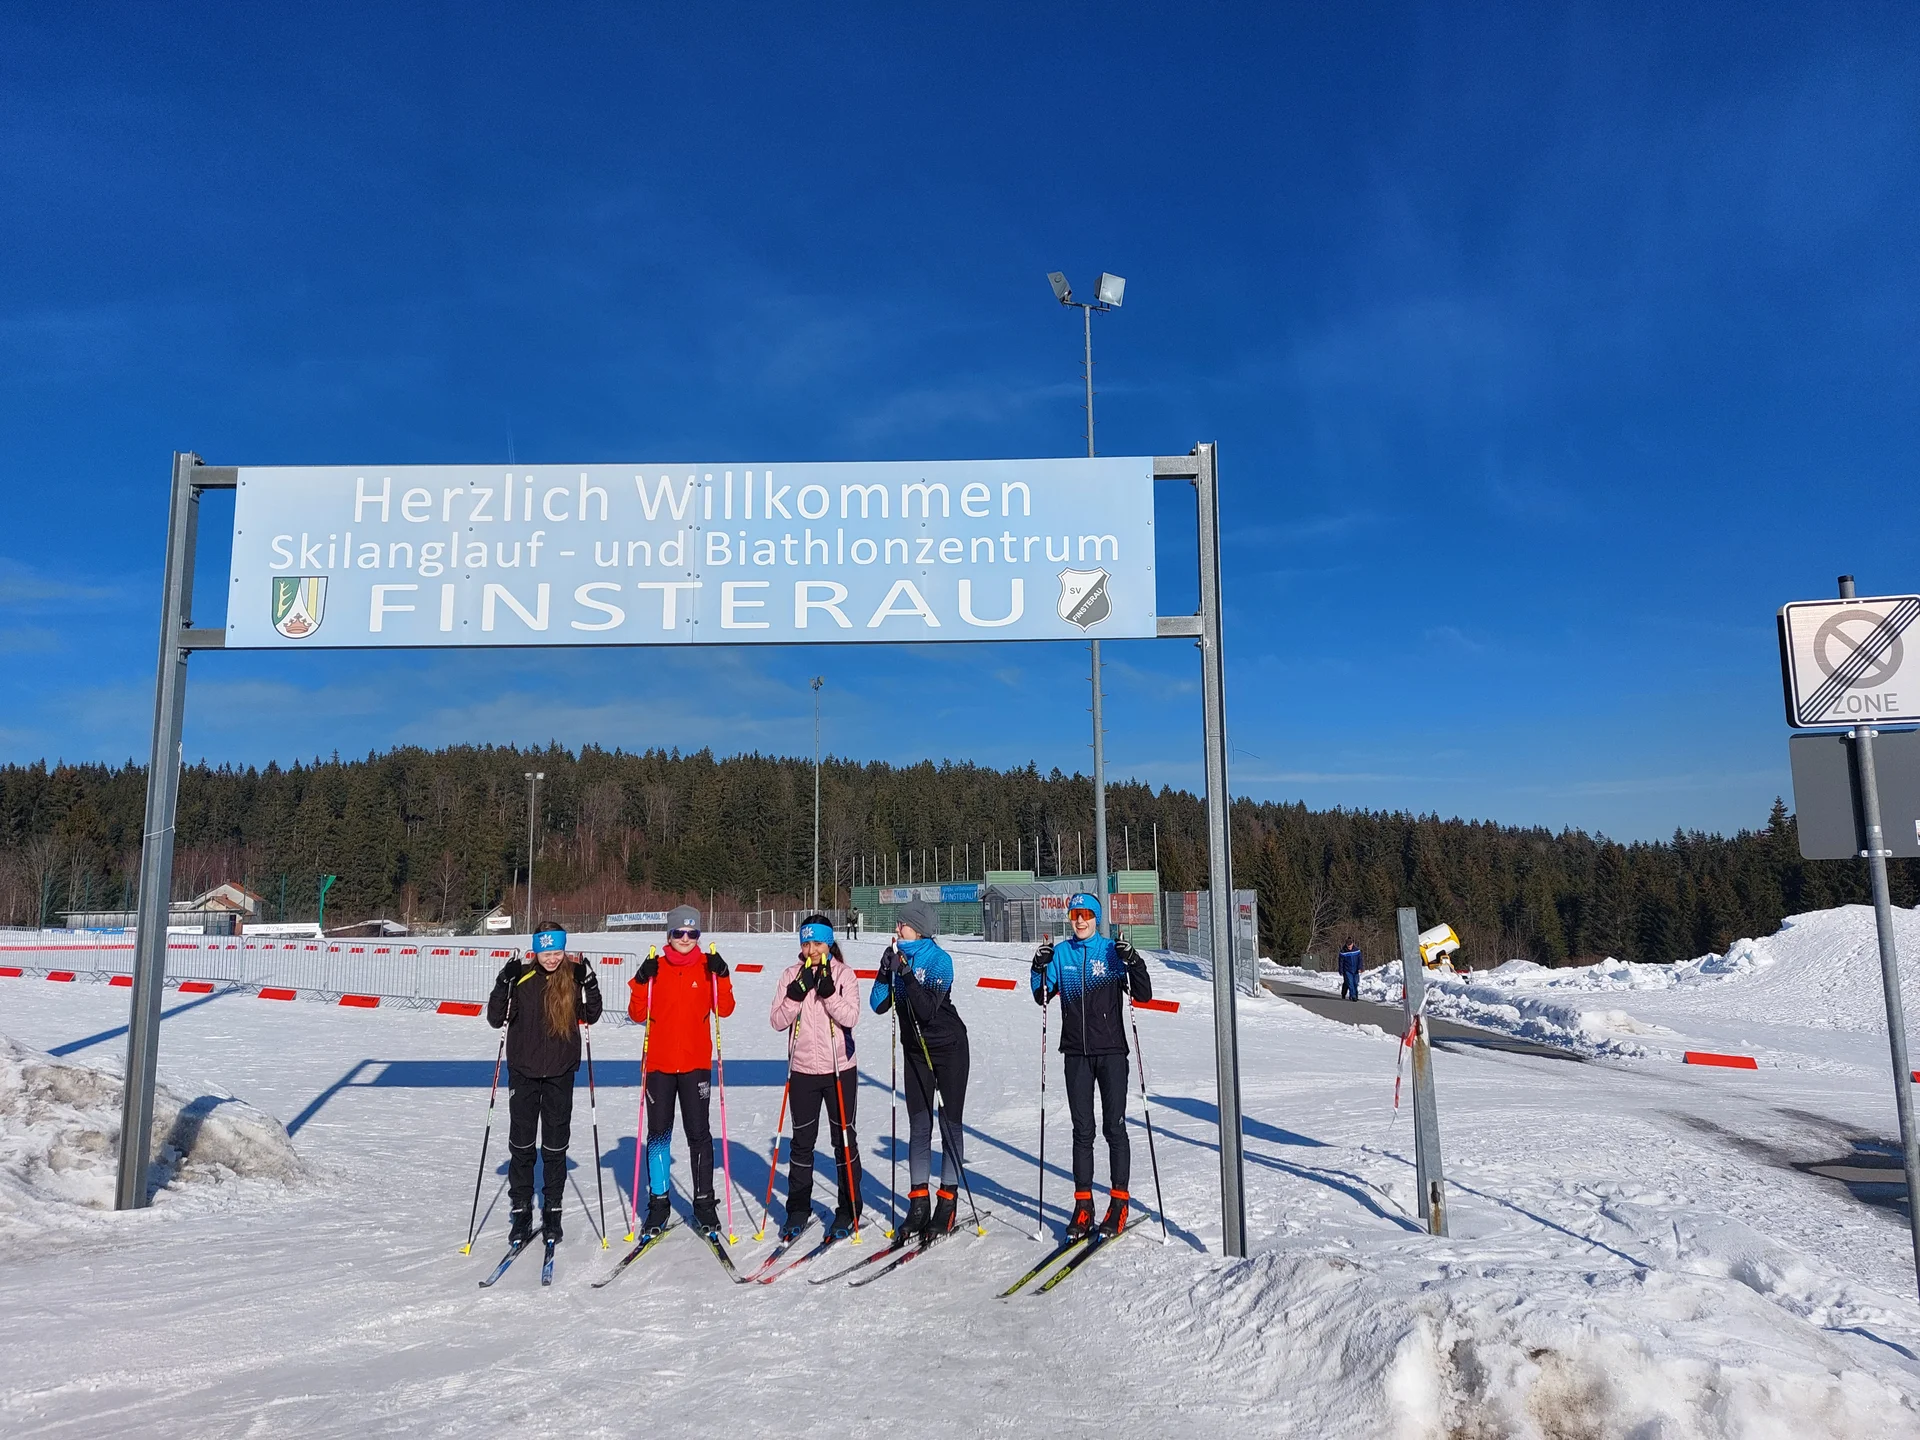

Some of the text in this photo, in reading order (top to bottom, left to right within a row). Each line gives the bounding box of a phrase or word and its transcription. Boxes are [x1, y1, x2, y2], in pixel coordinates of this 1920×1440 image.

[354, 468, 1032, 523] Herzlich Willkommen
[269, 531, 546, 578] Skilanglauf
[594, 530, 686, 567] und
[705, 528, 1120, 566] Biathlonzentrum
[368, 577, 1025, 633] FINSTERAU
[1069, 587, 1082, 595] SV
[1072, 587, 1104, 622] FINSTERAU
[1832, 693, 1900, 714] ZONE
